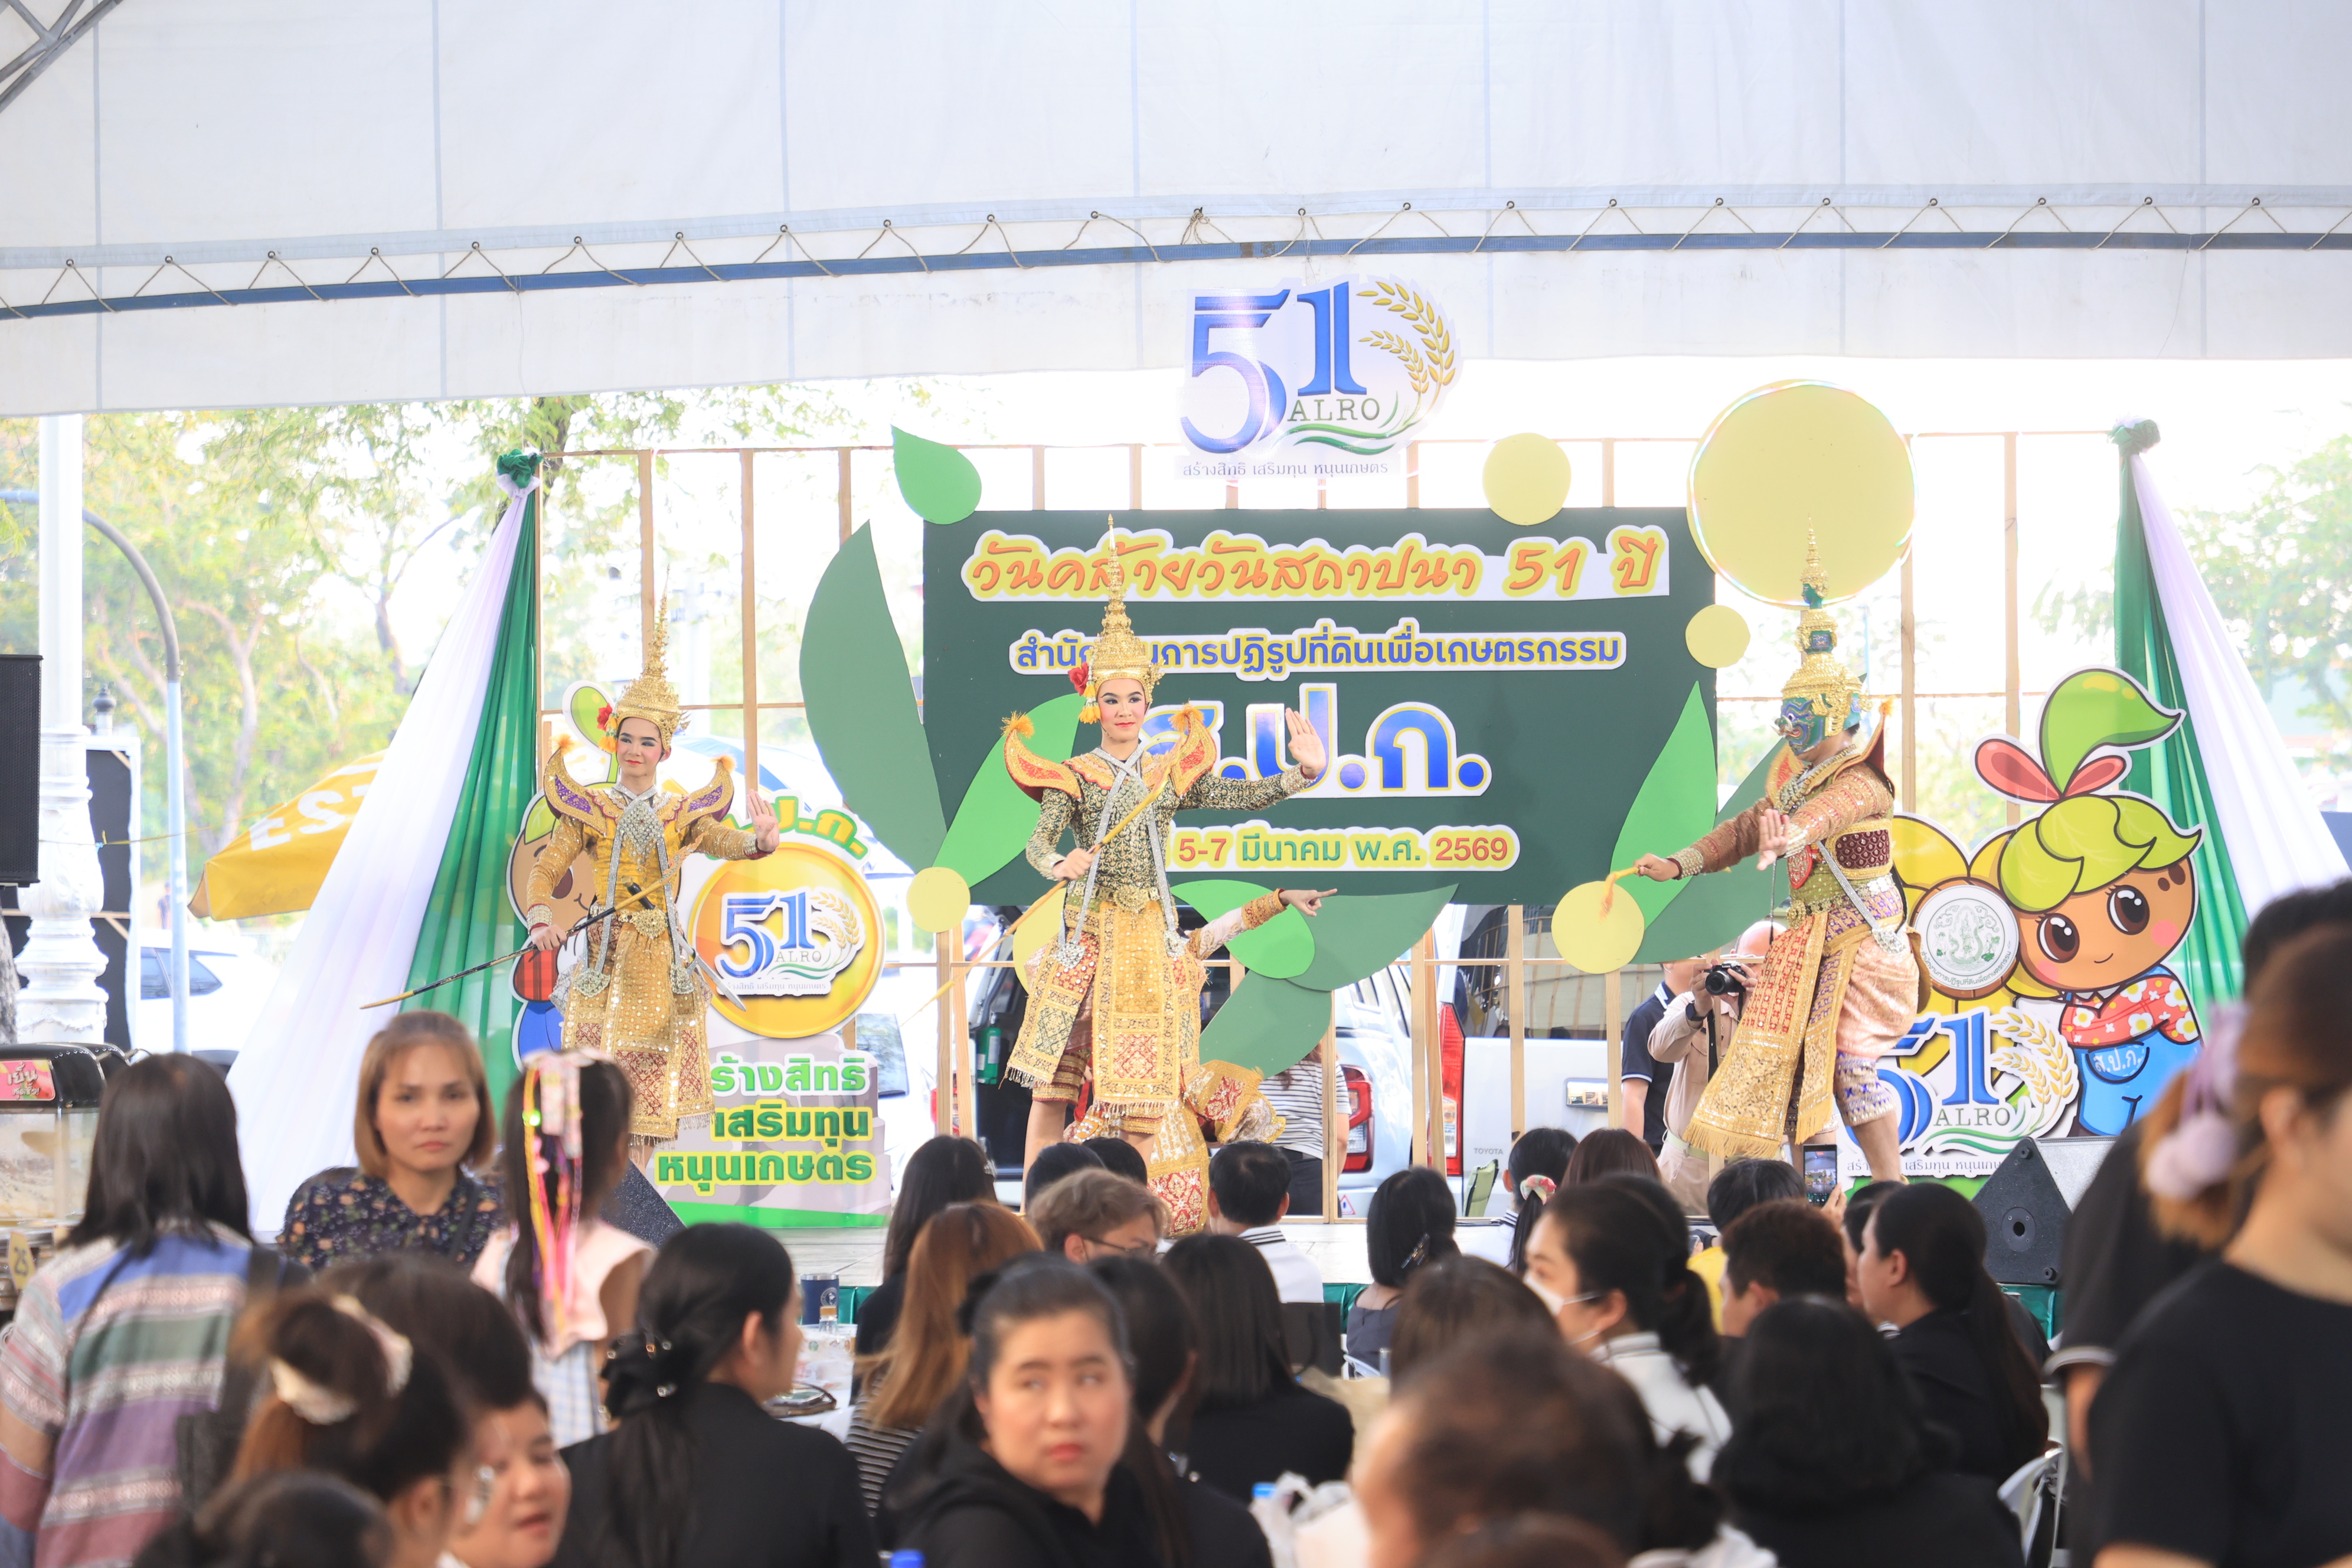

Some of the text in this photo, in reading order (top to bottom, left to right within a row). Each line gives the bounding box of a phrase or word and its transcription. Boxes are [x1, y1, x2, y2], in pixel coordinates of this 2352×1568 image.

[1181, 282, 1367, 453] 51
[1287, 399, 1380, 422] ALRO
[1183, 461, 1388, 478] สร้างสิทธิ เสริมทุน หนุนเกษตร
[972, 535, 1658, 591] วันคล้ายวันสถาปนา 51 ปี
[1017, 626, 1619, 672] สำนักการปฏิรูปที่ดินเพื่อเกษตรกรรม
[250, 783, 372, 851] ES
[1179, 834, 1508, 861] 5-7 มีนาคม พ.ศ. 2569
[720, 891, 815, 978] 51
[775, 951, 822, 963] ALRO
[757, 982, 785, 991] เสริมทุน
[788, 983, 827, 991] หนุนเกษตร
[711, 1056, 866, 1091] ร้างสิทธิ
[2093, 1047, 2142, 1072] ส.ป.ก.
[714, 1103, 869, 1148] เสริมทุน
[1933, 1108, 2011, 1126] ALRO
[658, 1155, 873, 1192] หนุนเกษตร
[1905, 1159, 2002, 1173] เสริมทุน หนุนเกษ
